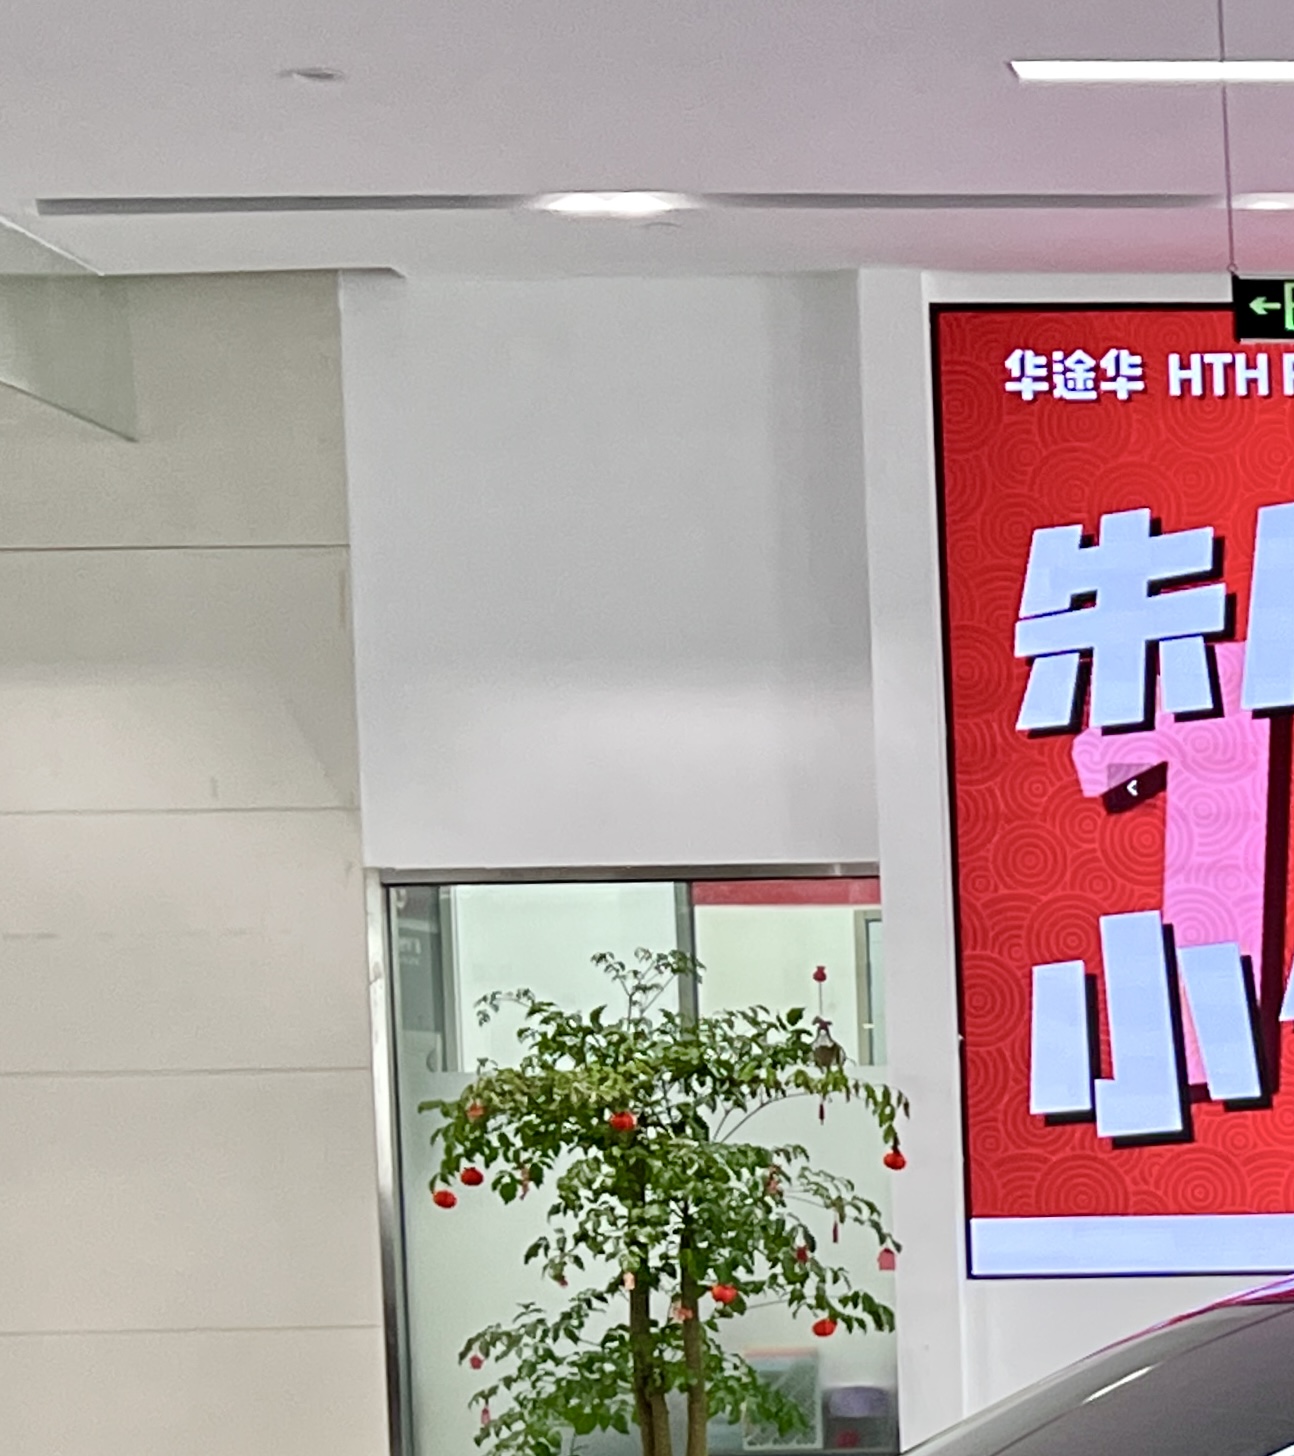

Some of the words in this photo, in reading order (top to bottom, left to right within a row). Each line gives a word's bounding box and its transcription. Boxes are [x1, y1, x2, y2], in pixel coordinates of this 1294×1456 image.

[1004, 348, 1146, 400] 华途华
[1169, 351, 1270, 396] HTH
